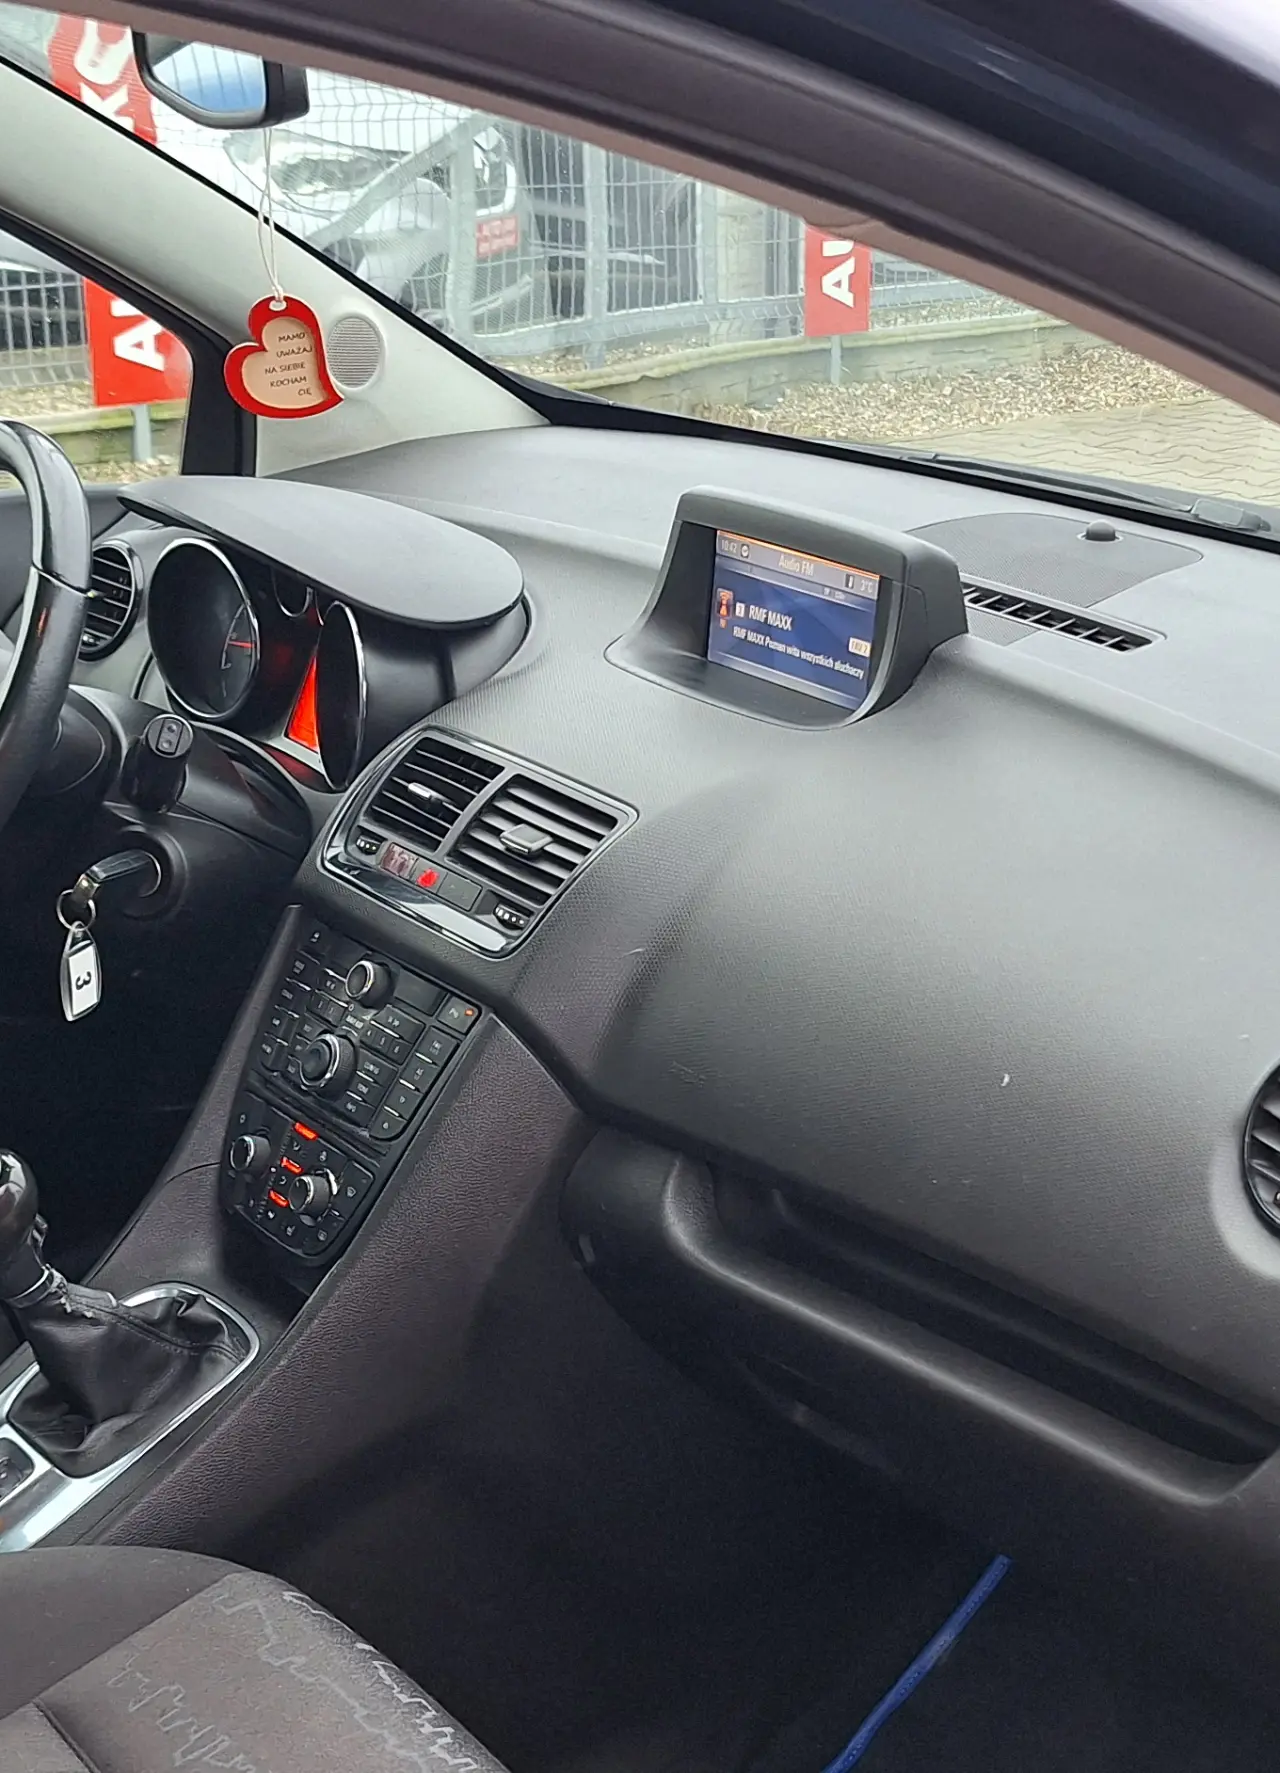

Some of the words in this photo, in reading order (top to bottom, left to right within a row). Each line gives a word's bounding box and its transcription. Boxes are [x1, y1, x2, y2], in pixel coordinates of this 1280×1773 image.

[277, 332, 306, 342] MAMO
[279, 362, 306, 372] SIEBIE
[270, 376, 307, 387] KOCHAM
[778, 555, 800, 572] Audio
[801, 562, 815, 576] FM
[749, 605, 768, 622] RMF
[767, 610, 793, 631] MAXX
[733, 626, 747, 639] RMF
[747, 630, 765, 646] MAXX
